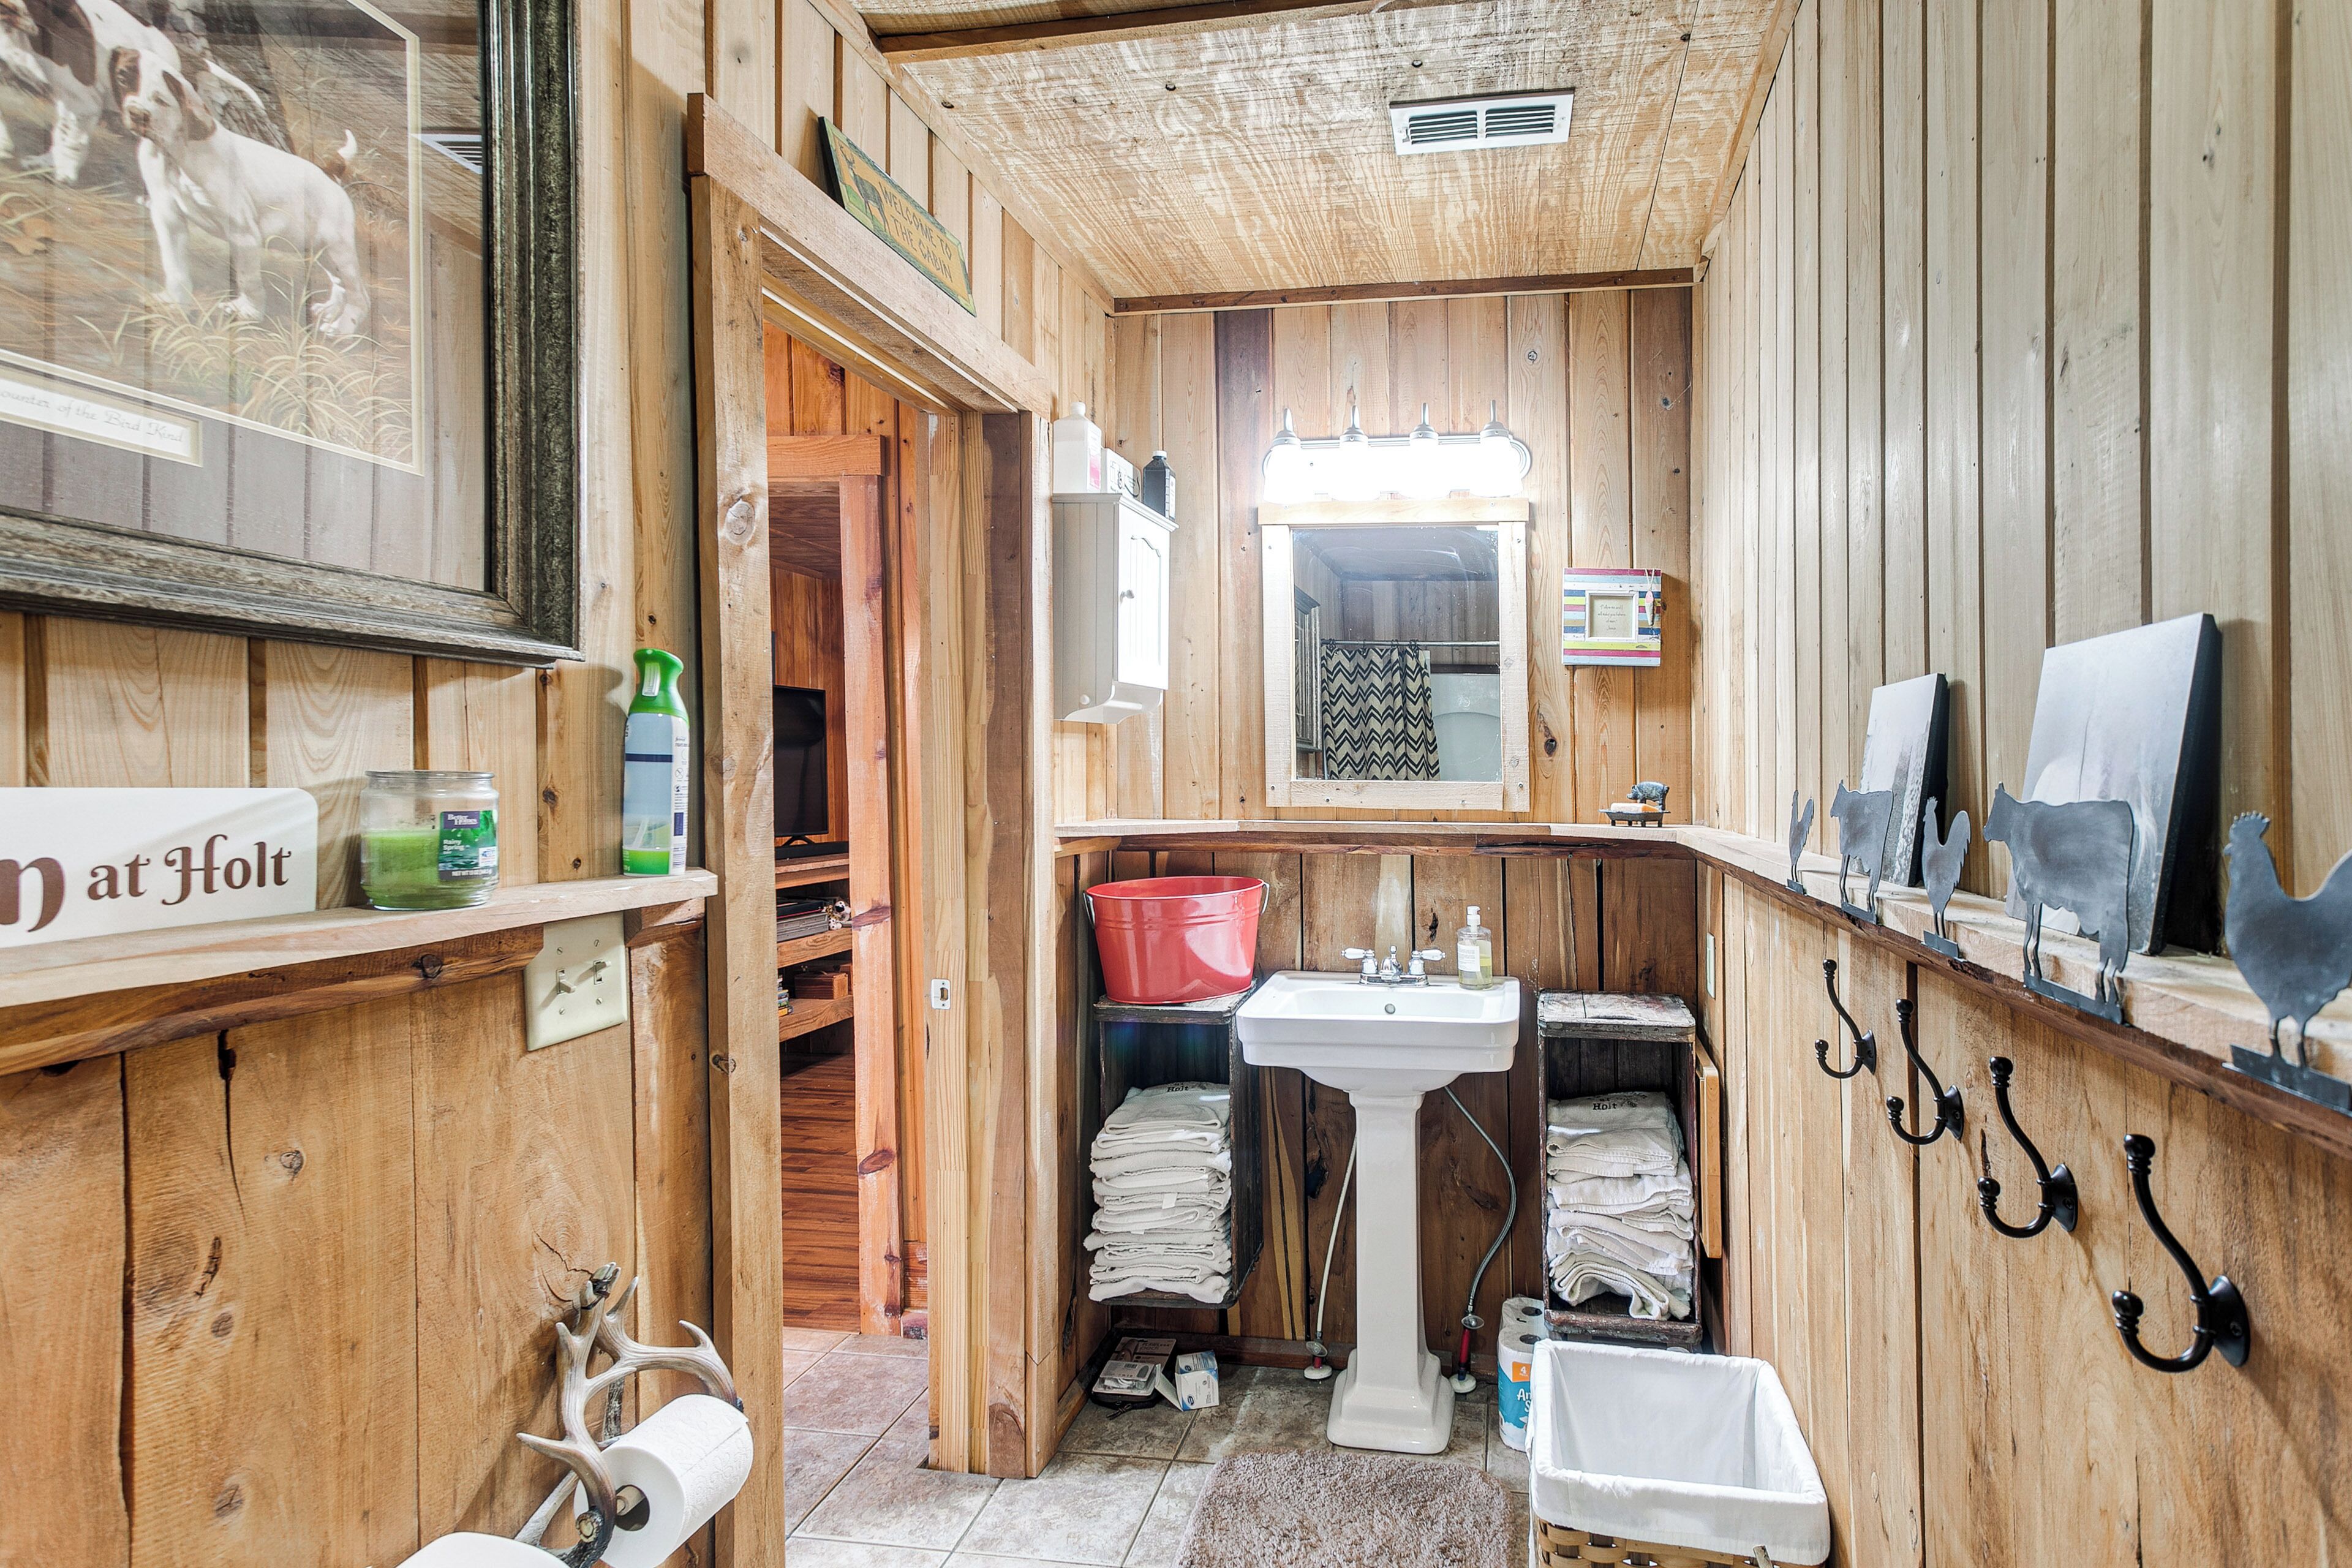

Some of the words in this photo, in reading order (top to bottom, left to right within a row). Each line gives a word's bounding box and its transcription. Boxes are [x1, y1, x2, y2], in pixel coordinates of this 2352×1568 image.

[878, 181, 937, 248] WELCOME
[937, 235, 952, 260] TO
[890, 214, 918, 252] THE
[919, 238, 953, 283] CABIN
[58, 399, 75, 418] of
[77, 403, 97, 421] the
[104, 410, 140, 431] Bird
[146, 421, 183, 442] Kind
[88, 854, 151, 900] at
[162, 834, 292, 905] Holt
